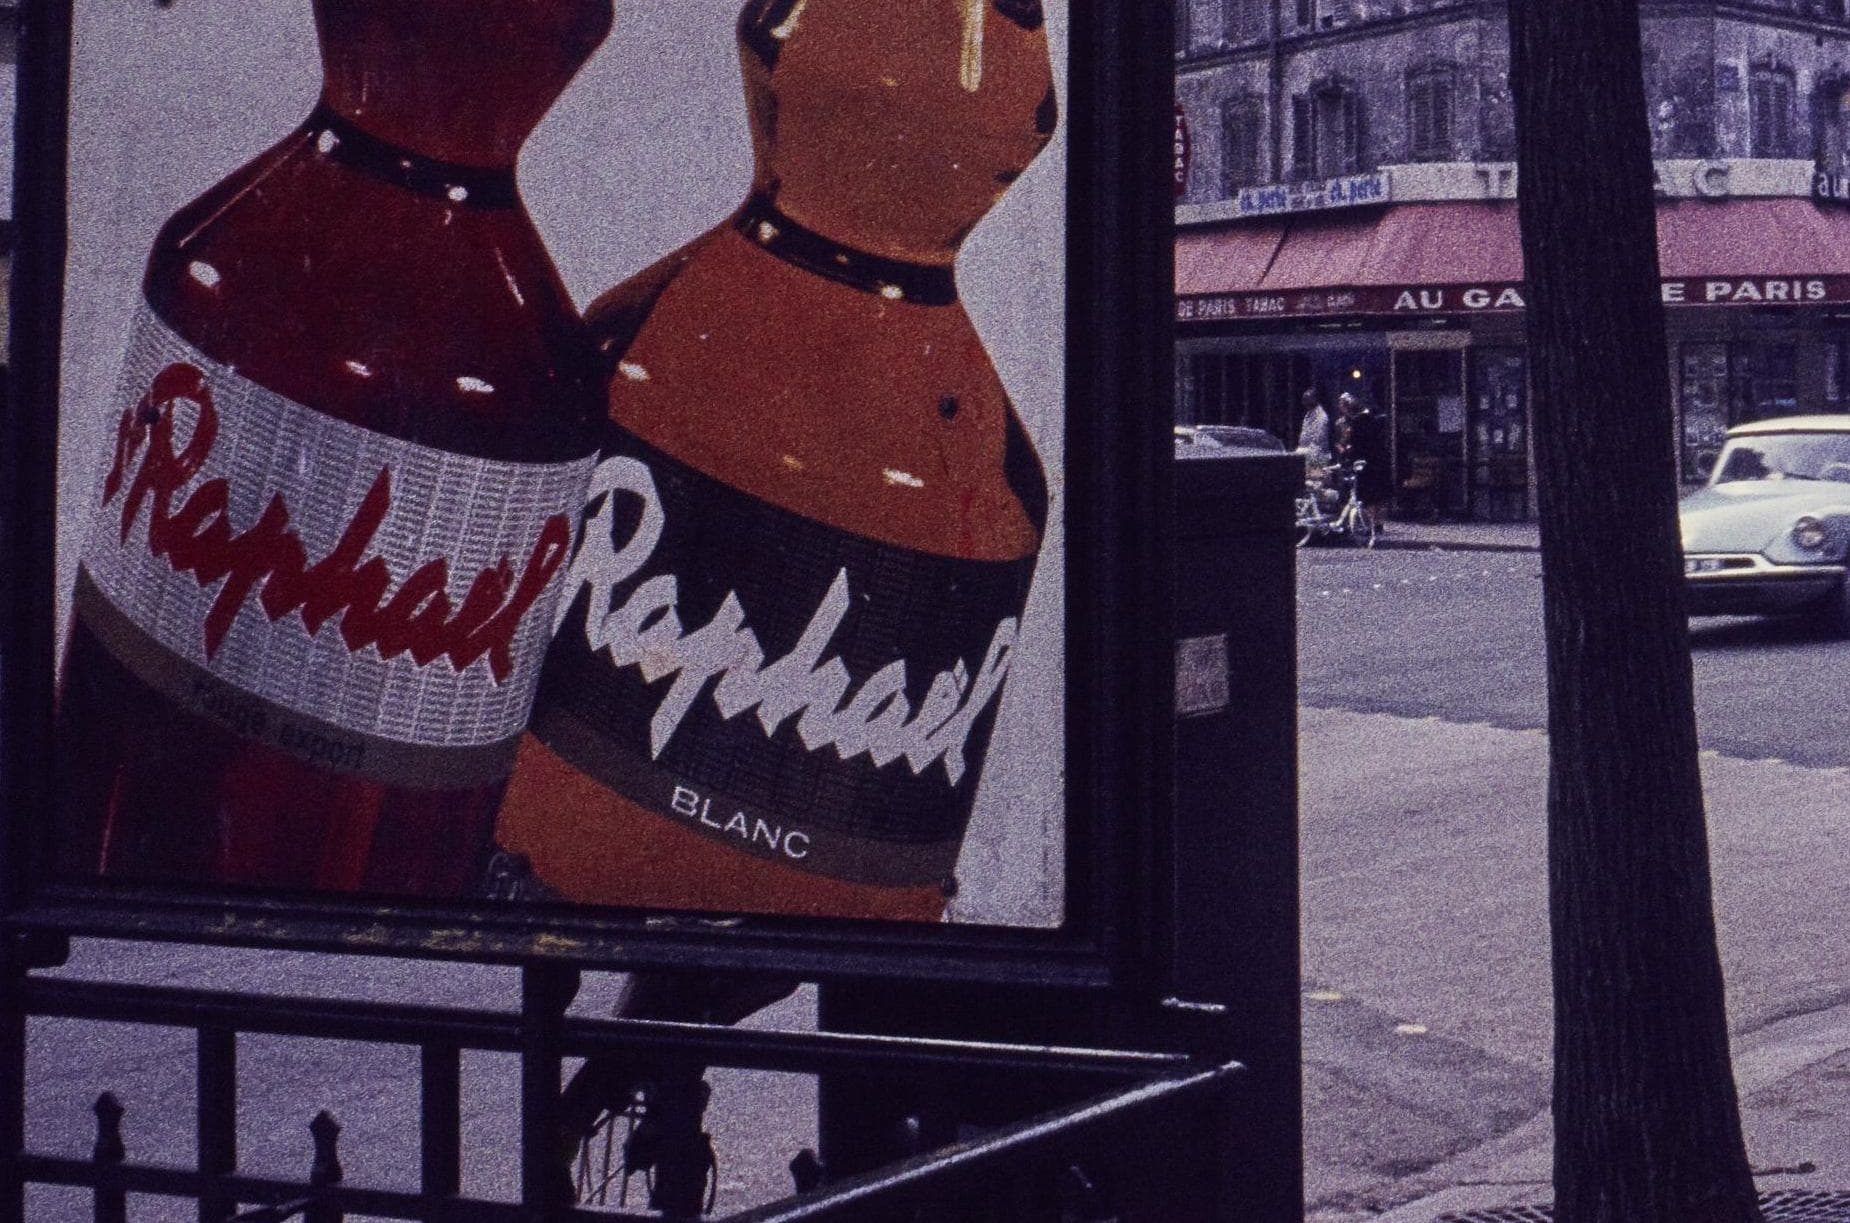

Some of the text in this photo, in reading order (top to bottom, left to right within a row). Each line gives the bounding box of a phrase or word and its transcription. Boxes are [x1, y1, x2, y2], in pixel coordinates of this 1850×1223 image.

[1197, 297, 1236, 316] PARIS
[1245, 295, 1286, 313] TABAC
[1393, 289, 1444, 310] AU
[1661, 282, 1686, 303] E
[1705, 280, 1827, 301] PARIS
[279, 722, 367, 772] export
[671, 785, 812, 861] BLANC
